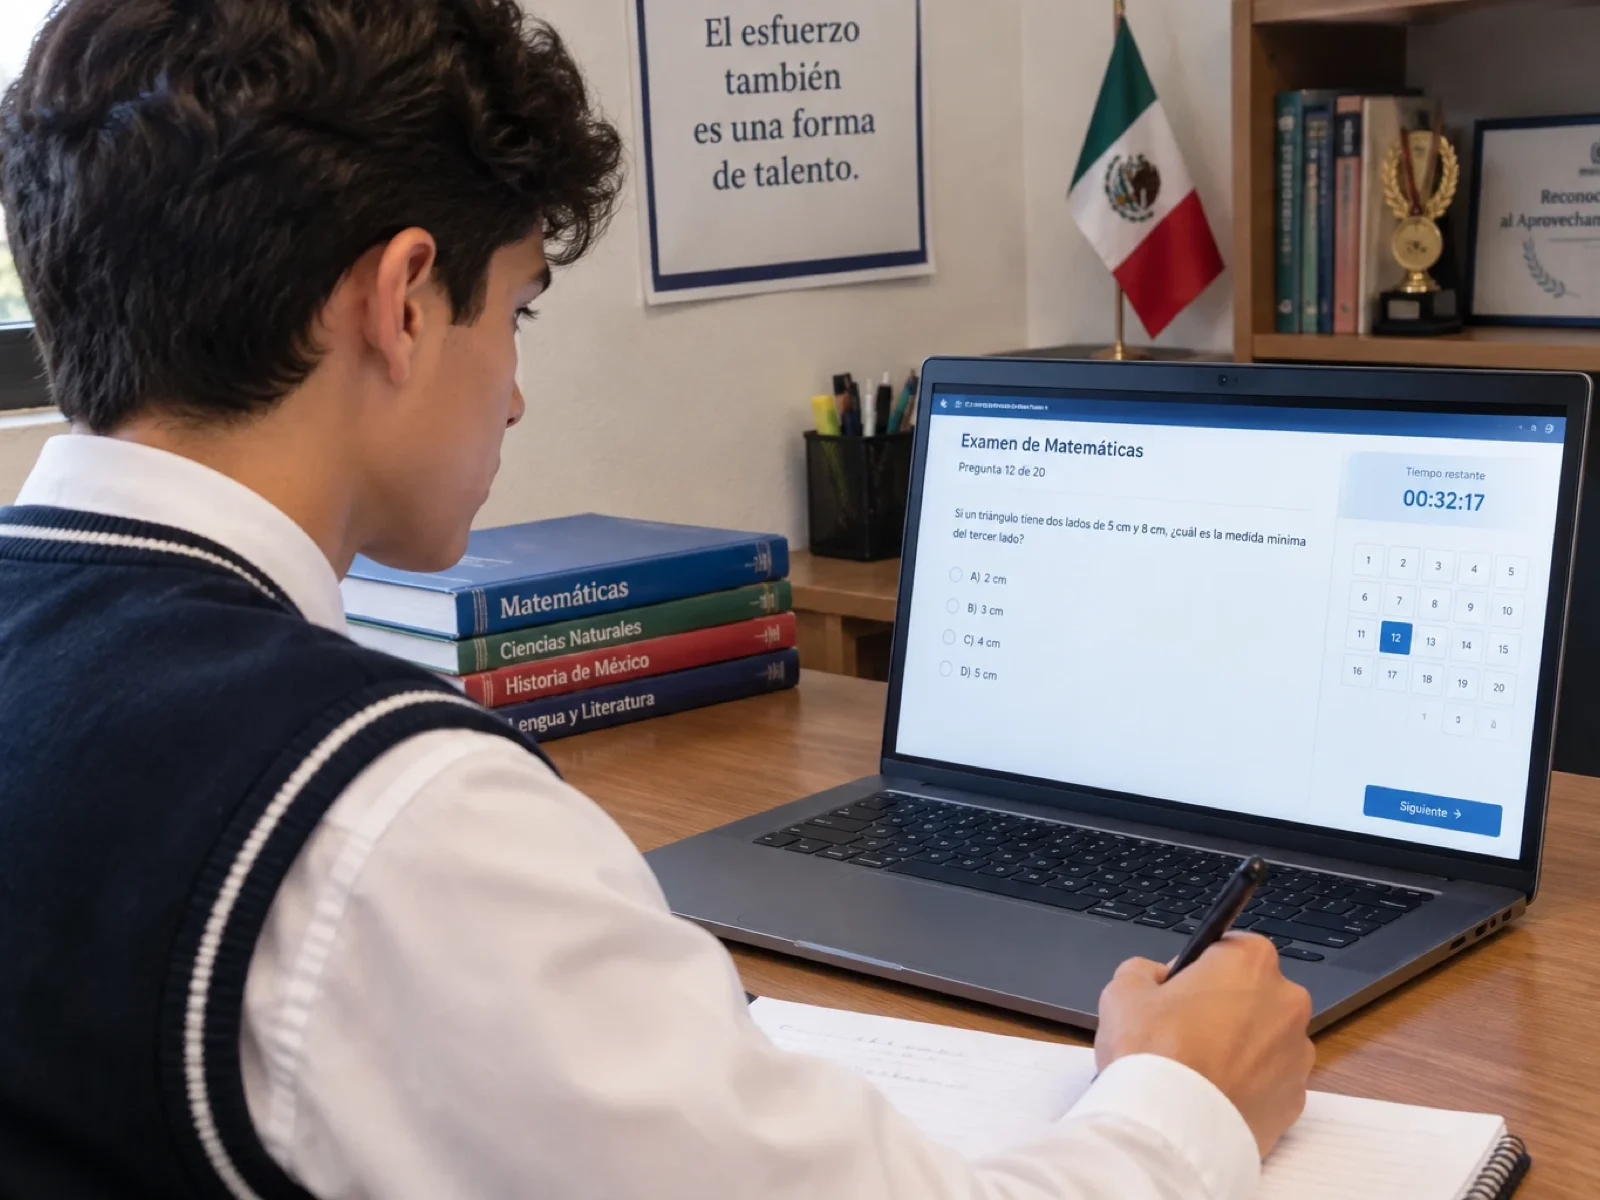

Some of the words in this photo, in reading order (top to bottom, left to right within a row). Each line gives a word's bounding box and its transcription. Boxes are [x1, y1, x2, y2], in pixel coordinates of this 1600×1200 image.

[705, 16, 731, 47] El
[741, 14, 860, 45] esfuerzo
[725, 61, 841, 95] también
[694, 121, 722, 144] es
[731, 117, 783, 142] una
[792, 108, 875, 138] forma
[713, 160, 745, 190] de
[754, 156, 859, 187] talento.
[1500, 211, 1513, 228] al
[961, 433, 1017, 451] Examen
[1022, 437, 1040, 452] de
[1045, 438, 1144, 458] Matemáticas
[958, 462, 1002, 476] Pregunta
[1005, 465, 1016, 476] 12
[1018, 466, 1031, 477] de
[1033, 467, 1046, 478] 20
[1406, 467, 1442, 479] Tiempo
[1445, 471, 1486, 481] restante
[1403, 489, 1485, 512] 00:32:17
[953, 529, 967, 539] del
[969, 531, 997, 542] tercer
[999, 533, 1025, 545] lado?
[955, 508, 964, 519] Si
[965, 511, 977, 520] un
[1021, 514, 1045, 525] tiene
[1046, 516, 1063, 527] dos
[1065, 517, 1091, 530] lados
[1093, 519, 1106, 531] de
[1107, 521, 1114, 531] 5
[1116, 523, 1131, 532] cm
[1133, 525, 1140, 535] y
[1141, 524, 1148, 534] 8
[1150, 526, 1168, 537] cm,
[1199, 529, 1211, 539] es
[1214, 529, 1223, 540] la
[1225, 531, 1264, 544] medida
[1366, 556, 1371, 565] 1
[1400, 558, 1407, 568] 2
[1435, 561, 1442, 571] 3
[1471, 564, 1478, 573] 4
[1508, 567, 1515, 576] 5
[970, 572, 981, 584] A)
[984, 573, 991, 583] 2
[992, 576, 1007, 585] cm
[500, 581, 629, 618] Matemáticas
[967, 603, 977, 615] B)
[981, 605, 987, 615] 3
[989, 607, 1004, 616] cm
[1362, 593, 1368, 602] 6
[1396, 596, 1403, 605] 7
[1431, 599, 1438, 609] 8
[1467, 603, 1474, 612] 9
[1502, 606, 1513, 616] 10
[500, 635, 566, 660] Ciencias
[570, 620, 642, 647] Naturales
[963, 634, 974, 647] C)
[977, 636, 984, 646] 4
[986, 639, 1001, 648] cm
[1357, 629, 1366, 639] 11
[1391, 633, 1401, 643] 12
[1426, 637, 1436, 647] 13
[1461, 640, 1472, 650] 14
[1498, 645, 1509, 654] 15
[506, 670, 568, 695] Historia
[572, 664, 590, 682] de
[594, 655, 649, 677] México
[960, 666, 971, 678] D)
[974, 668, 981, 678] 5
[982, 671, 997, 681] cm
[1352, 666, 1362, 675] 16
[1387, 670, 1398, 679] 17
[1422, 674, 1433, 684] 18
[1457, 679, 1468, 688] 19
[1493, 683, 1505, 693] 20
[508, 712, 566, 732] engua
[569, 709, 578, 726] y
[582, 693, 655, 719] Literatura
[1400, 801, 1448, 817] Siguiente
